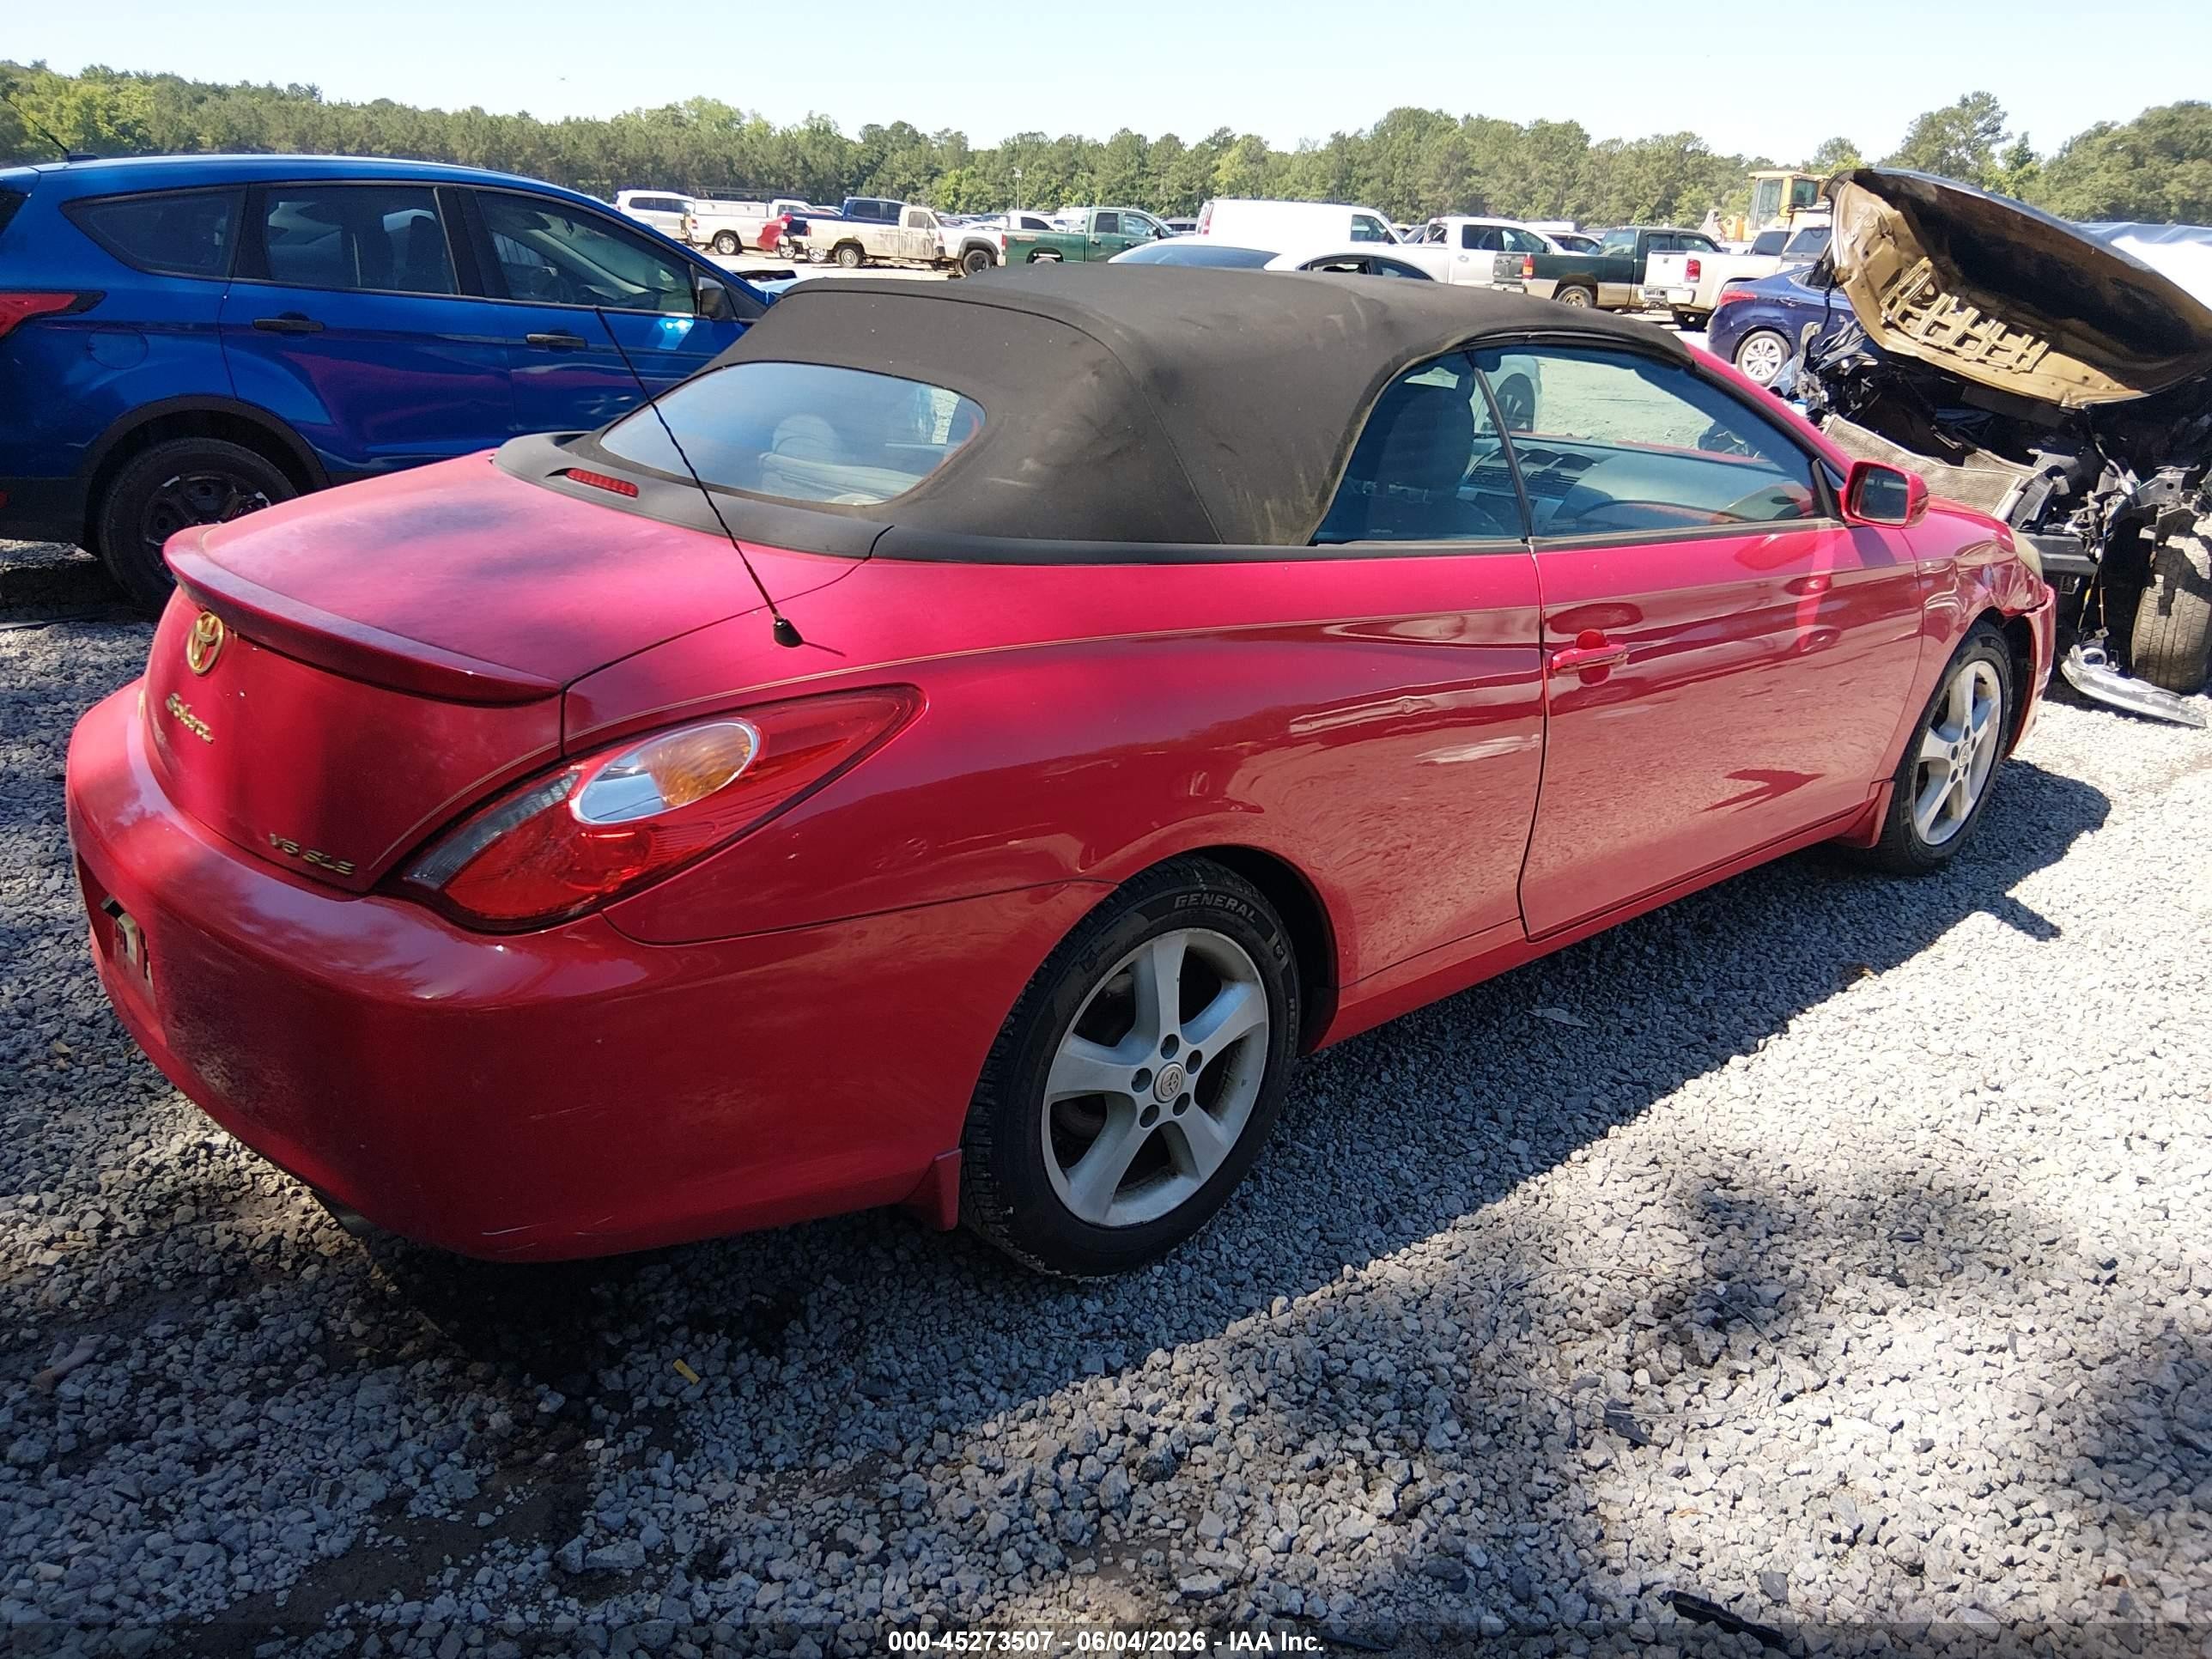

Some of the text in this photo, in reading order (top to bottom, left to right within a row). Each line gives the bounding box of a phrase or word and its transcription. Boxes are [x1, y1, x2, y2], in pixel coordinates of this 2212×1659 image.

[270, 833, 356, 875] V6 SLE
[1174, 893, 1256, 923] GENERAL
